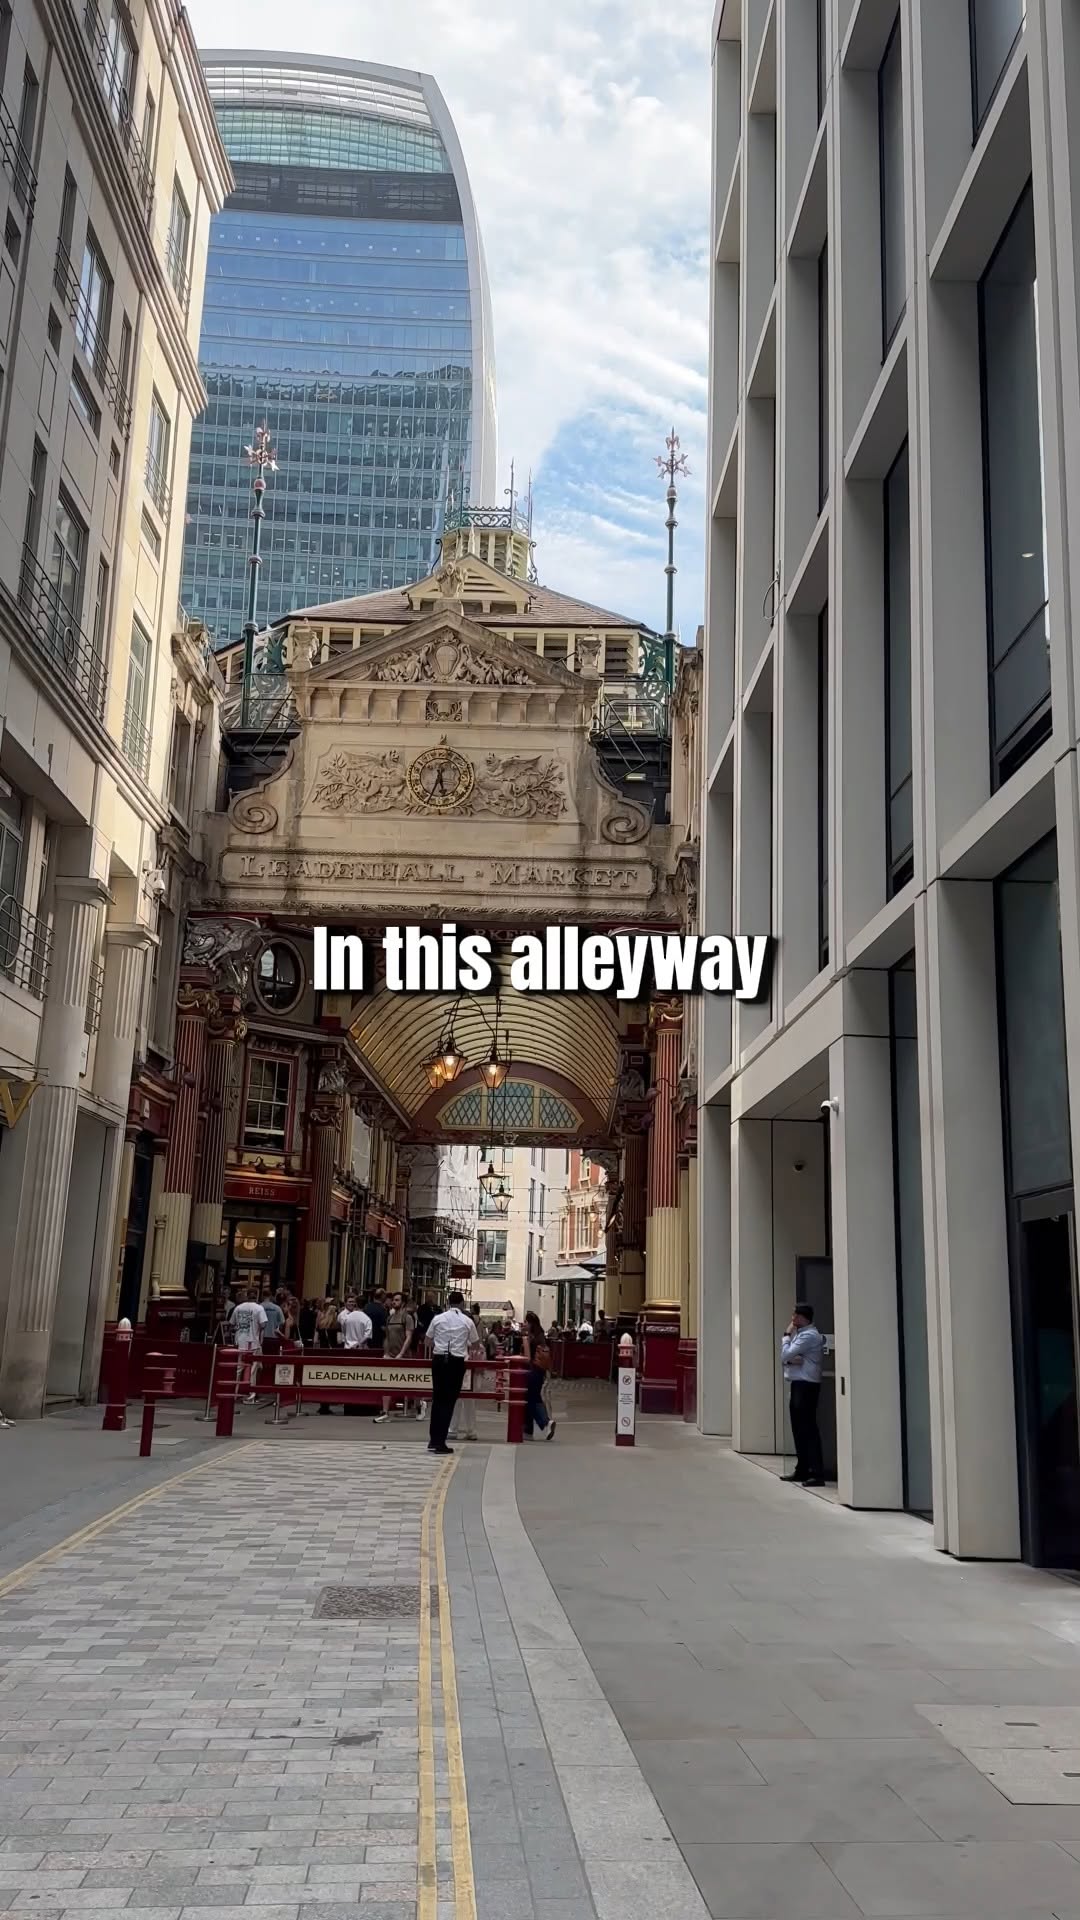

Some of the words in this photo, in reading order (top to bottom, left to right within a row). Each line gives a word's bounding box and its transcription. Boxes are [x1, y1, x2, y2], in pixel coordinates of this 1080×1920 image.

[240, 855, 464, 883] LEADENHALL
[489, 862, 638, 888] MARKET
[308, 1371, 387, 1383] LEADENHALL
